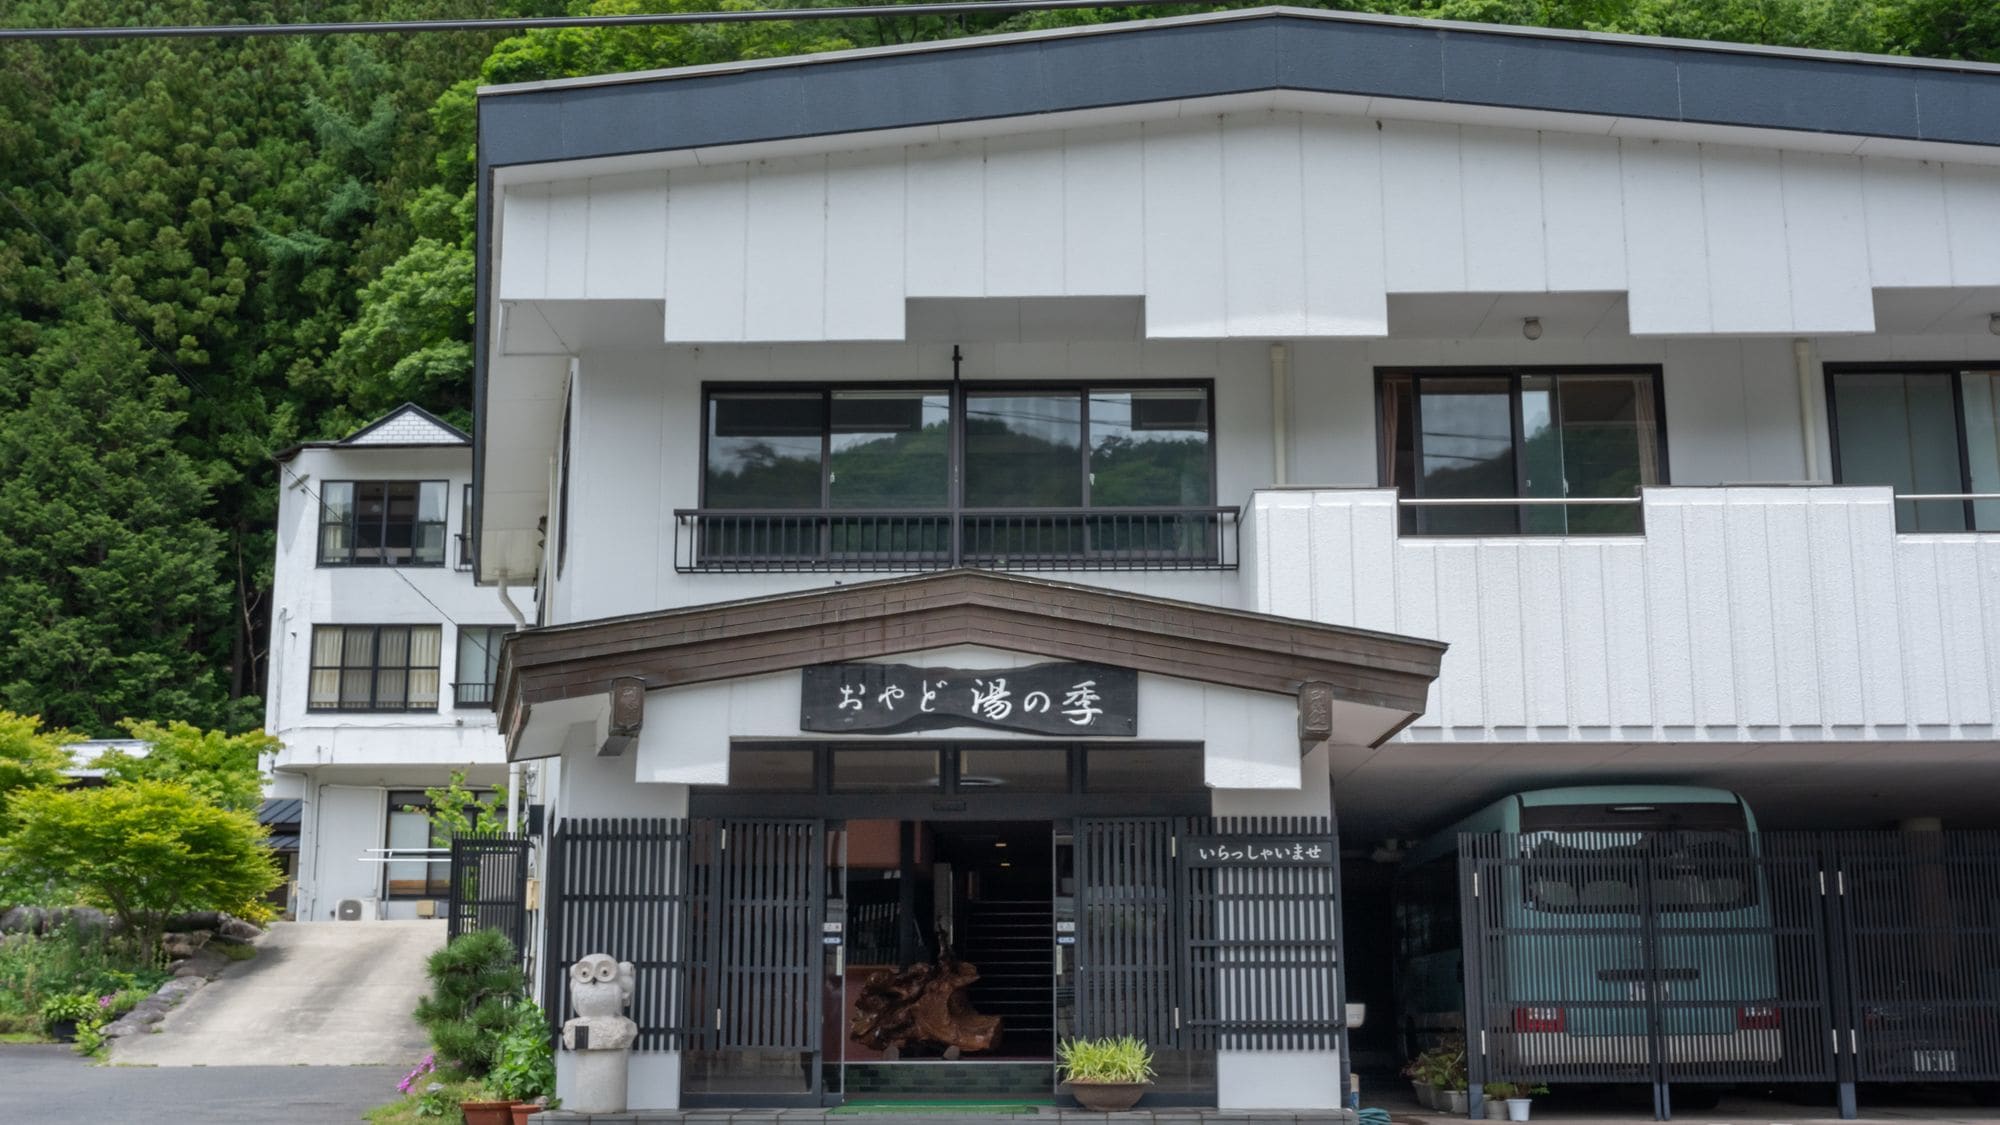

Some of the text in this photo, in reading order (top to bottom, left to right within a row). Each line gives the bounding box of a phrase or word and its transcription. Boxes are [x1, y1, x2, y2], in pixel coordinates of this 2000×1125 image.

[1199, 843, 1322, 861] いらっしゃいませ
